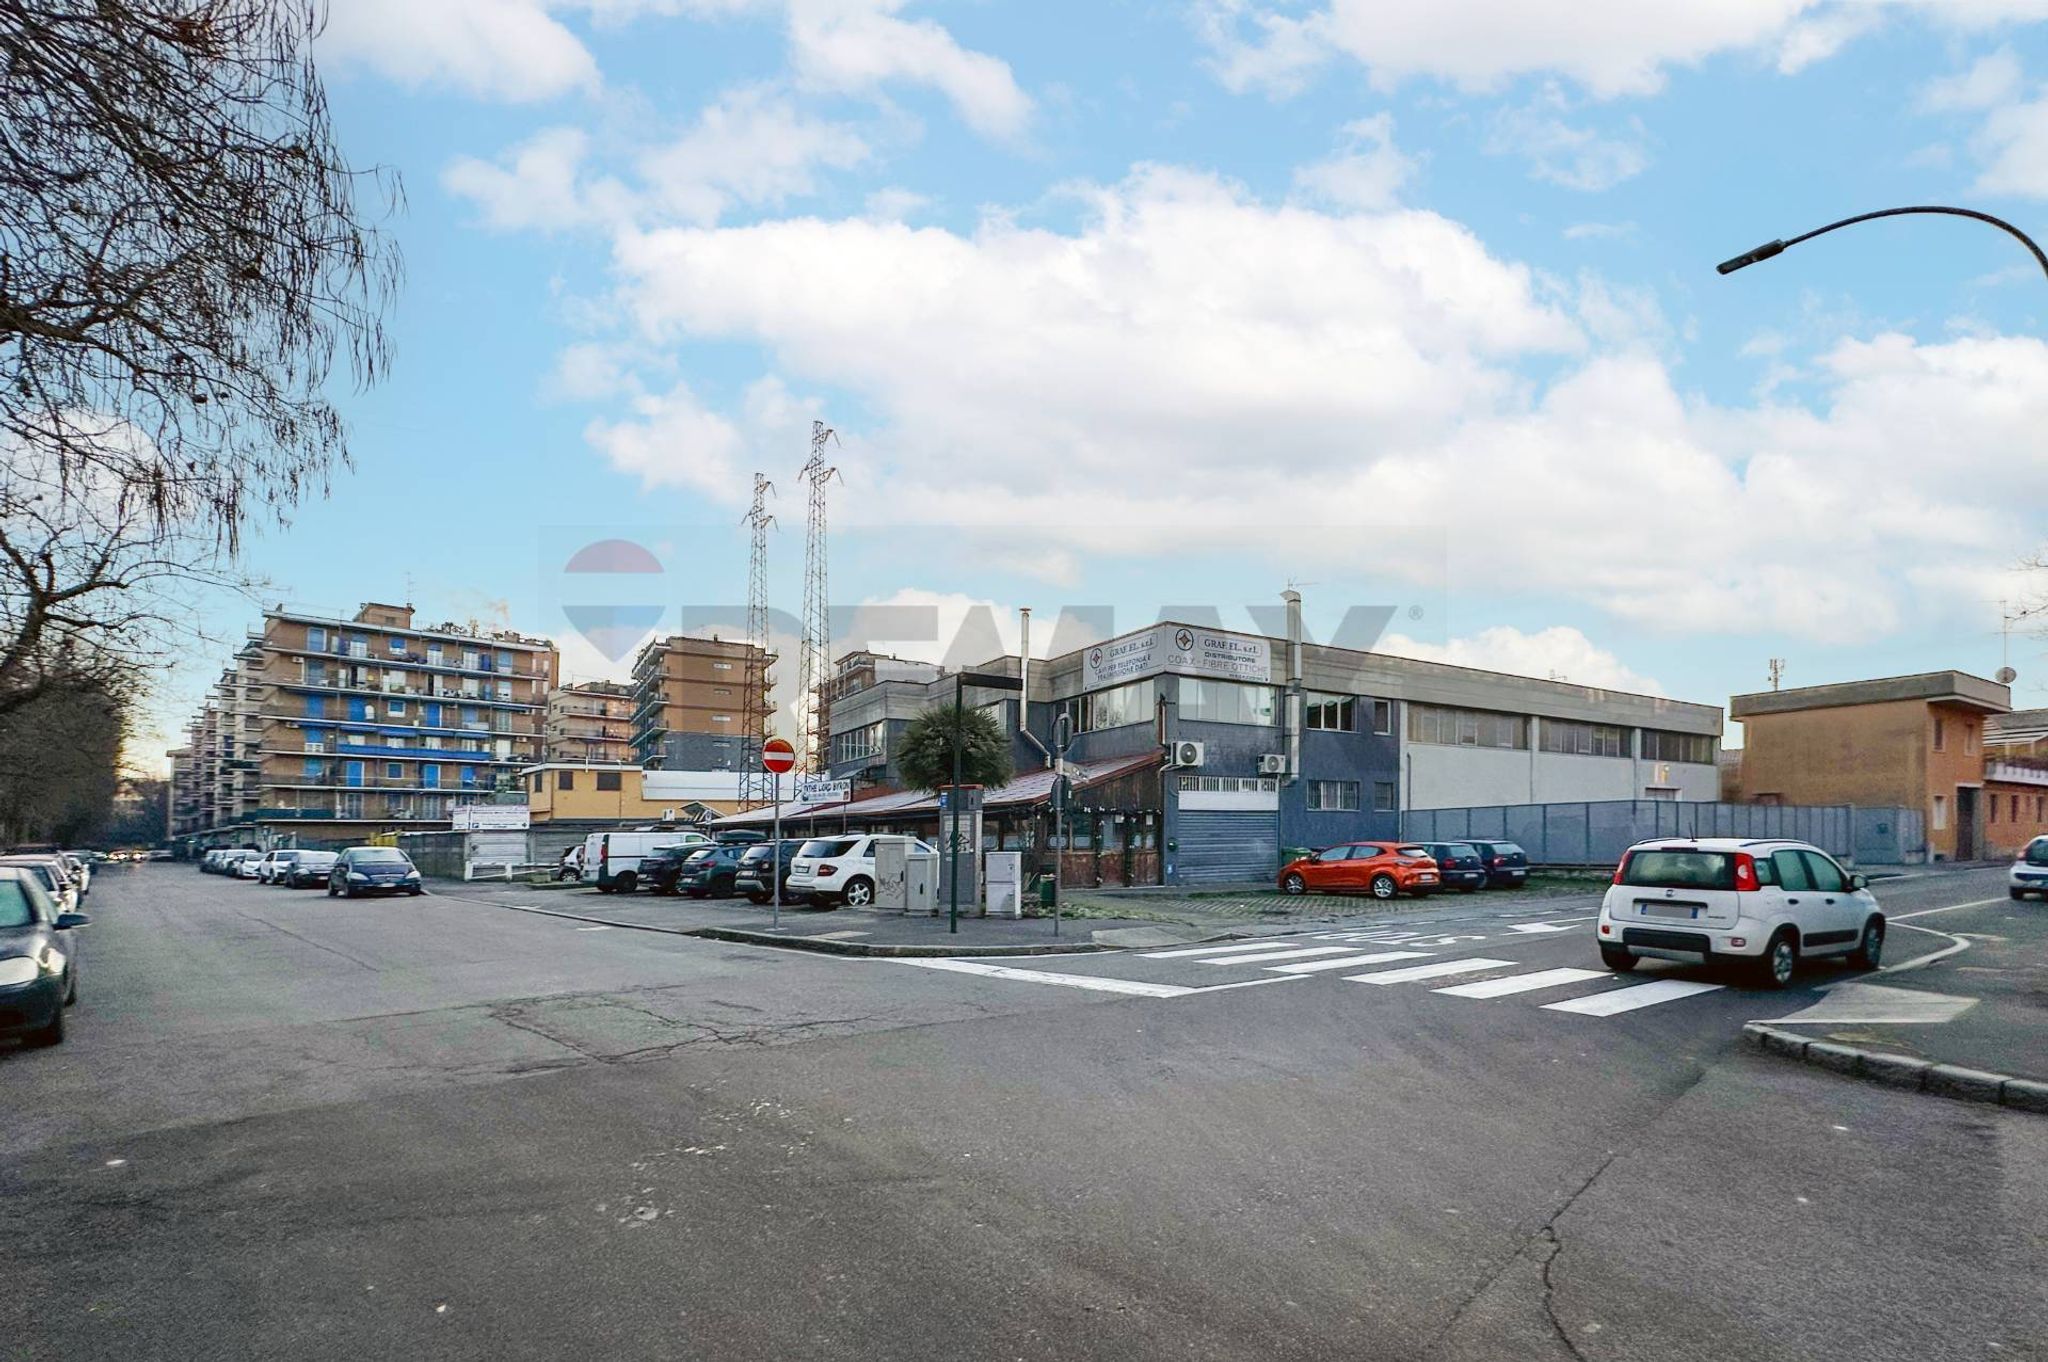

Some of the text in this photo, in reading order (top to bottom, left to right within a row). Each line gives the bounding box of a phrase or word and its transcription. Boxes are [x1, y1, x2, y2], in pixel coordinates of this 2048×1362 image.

[1167, 654, 1197, 666] COAX
[1203, 658, 1229, 670] FIBRE
[1231, 663, 1268, 674] OTTICHE
[1204, 651, 1256, 664] DISTRIBUTORE
